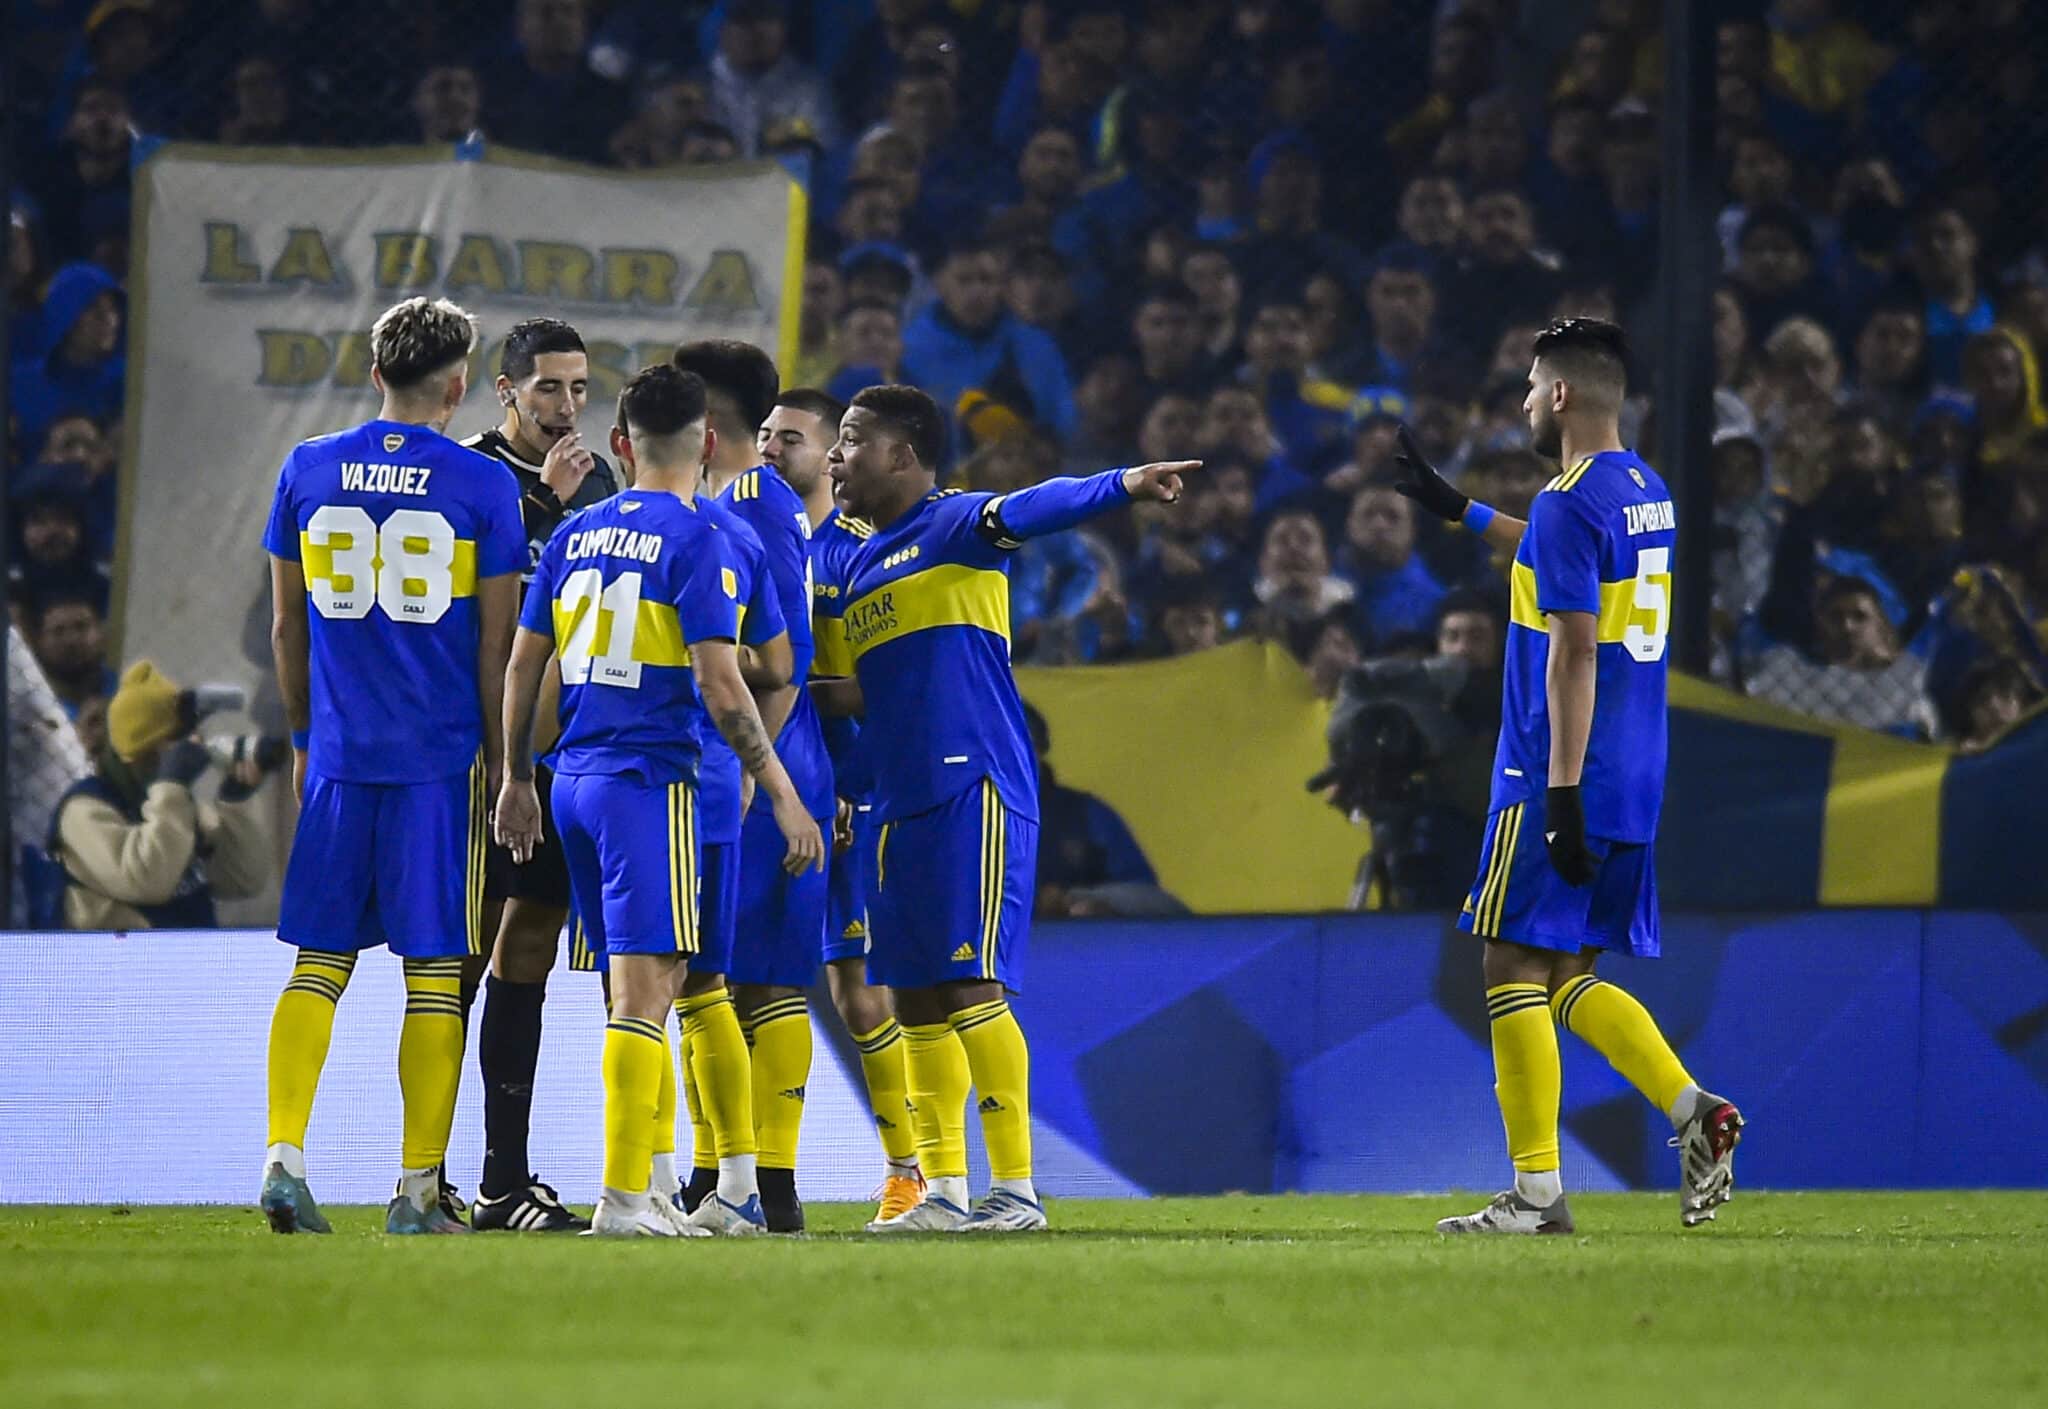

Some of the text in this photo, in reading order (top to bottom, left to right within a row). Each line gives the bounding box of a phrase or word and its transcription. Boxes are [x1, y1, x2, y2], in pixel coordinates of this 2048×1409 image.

[201, 223, 760, 309] LA BARRA
[307, 505, 455, 624] 38
[565, 526, 663, 564] CAMPUZANO
[1622, 500, 1676, 536] ZAMBRAN
[559, 568, 642, 689] 21
[1622, 547, 1668, 662] 5
